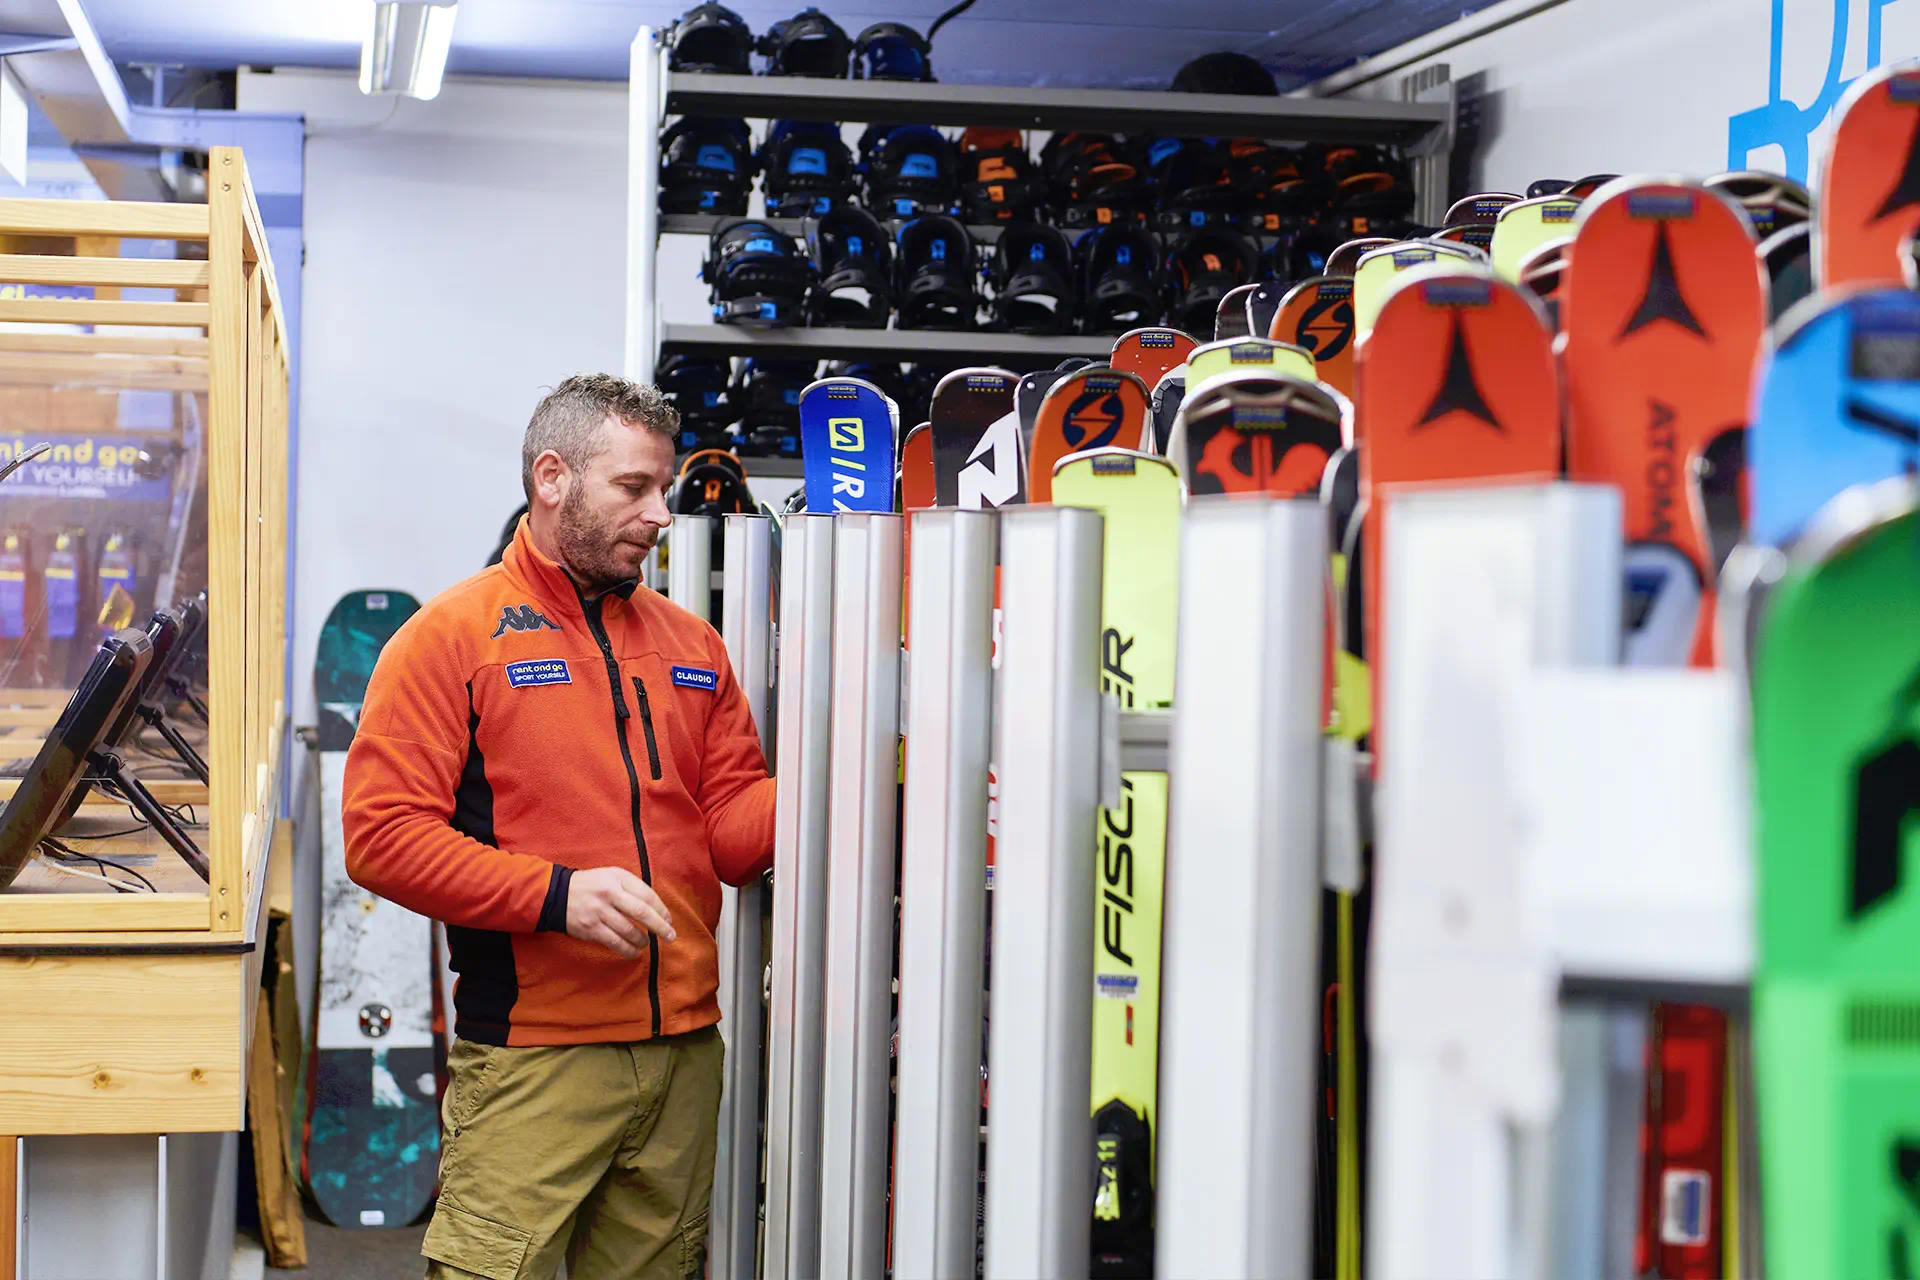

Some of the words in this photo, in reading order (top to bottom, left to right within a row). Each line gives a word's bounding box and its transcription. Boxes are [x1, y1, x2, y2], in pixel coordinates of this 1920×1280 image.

[98, 446, 138, 468] go
[512, 665, 533, 675] rent
[552, 664, 563, 672] go
[676, 671, 712, 684] CLAUDIO
[1103, 627, 1134, 968] FISCR
